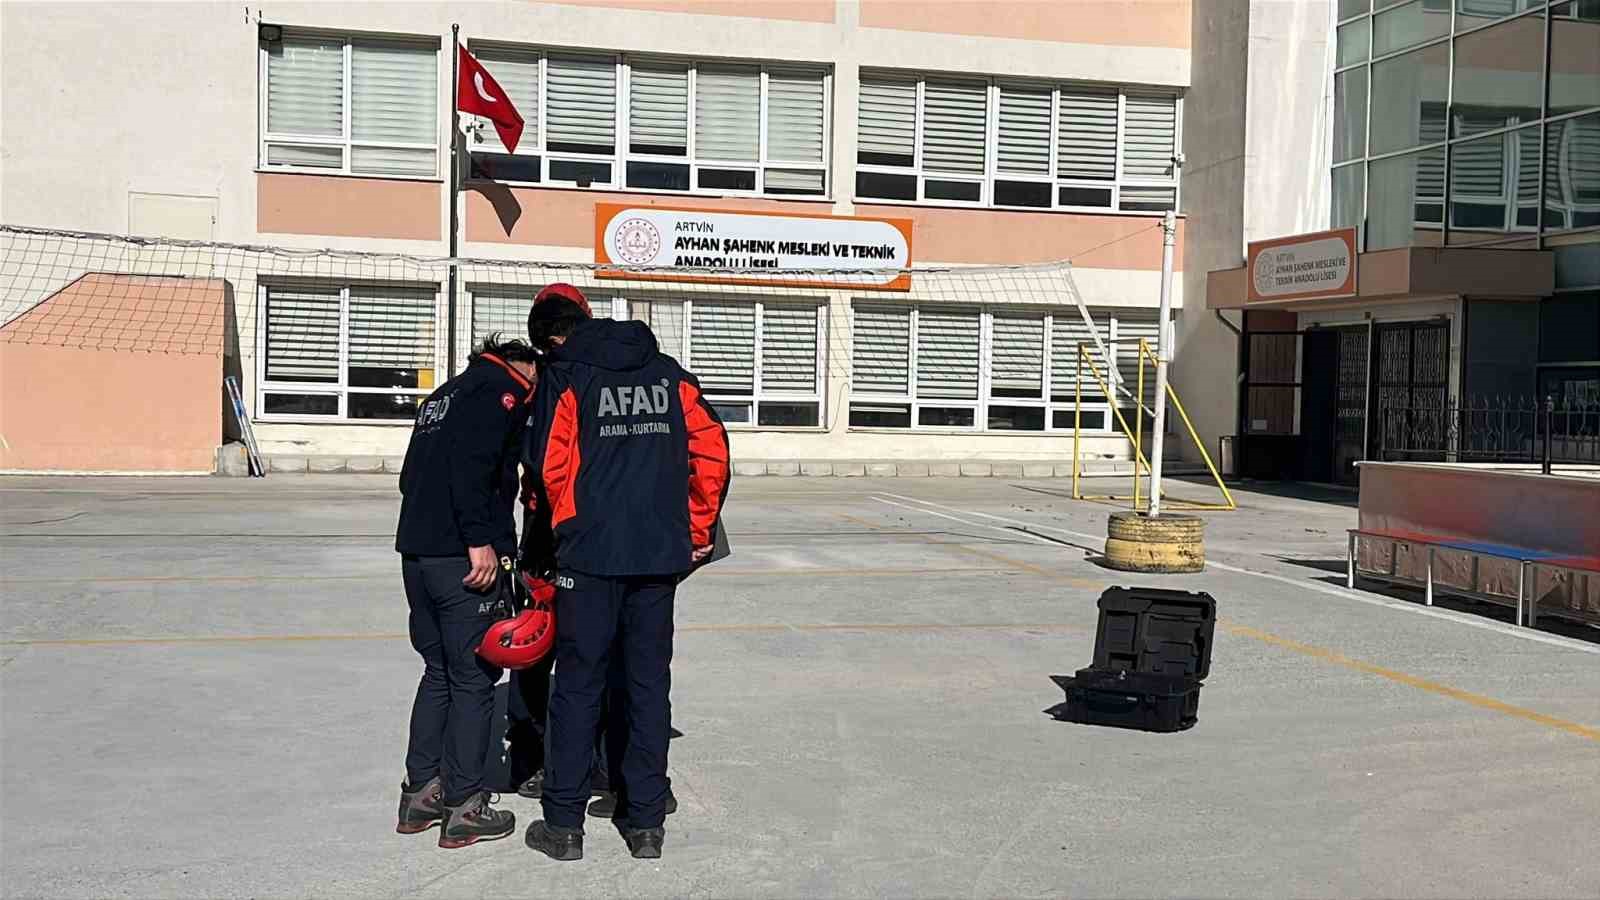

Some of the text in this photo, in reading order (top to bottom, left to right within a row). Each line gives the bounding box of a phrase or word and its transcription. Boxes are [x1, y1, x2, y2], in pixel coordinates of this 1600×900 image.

[674, 221, 714, 233] ARTVİN
[674, 236, 720, 251] AYHAN
[723, 239, 775, 255] ŞAHENK
[778, 240, 830, 257] MESLEKİ
[833, 244, 849, 258] VE
[851, 243, 896, 260] TEKNİK
[597, 384, 669, 417] AFAD
